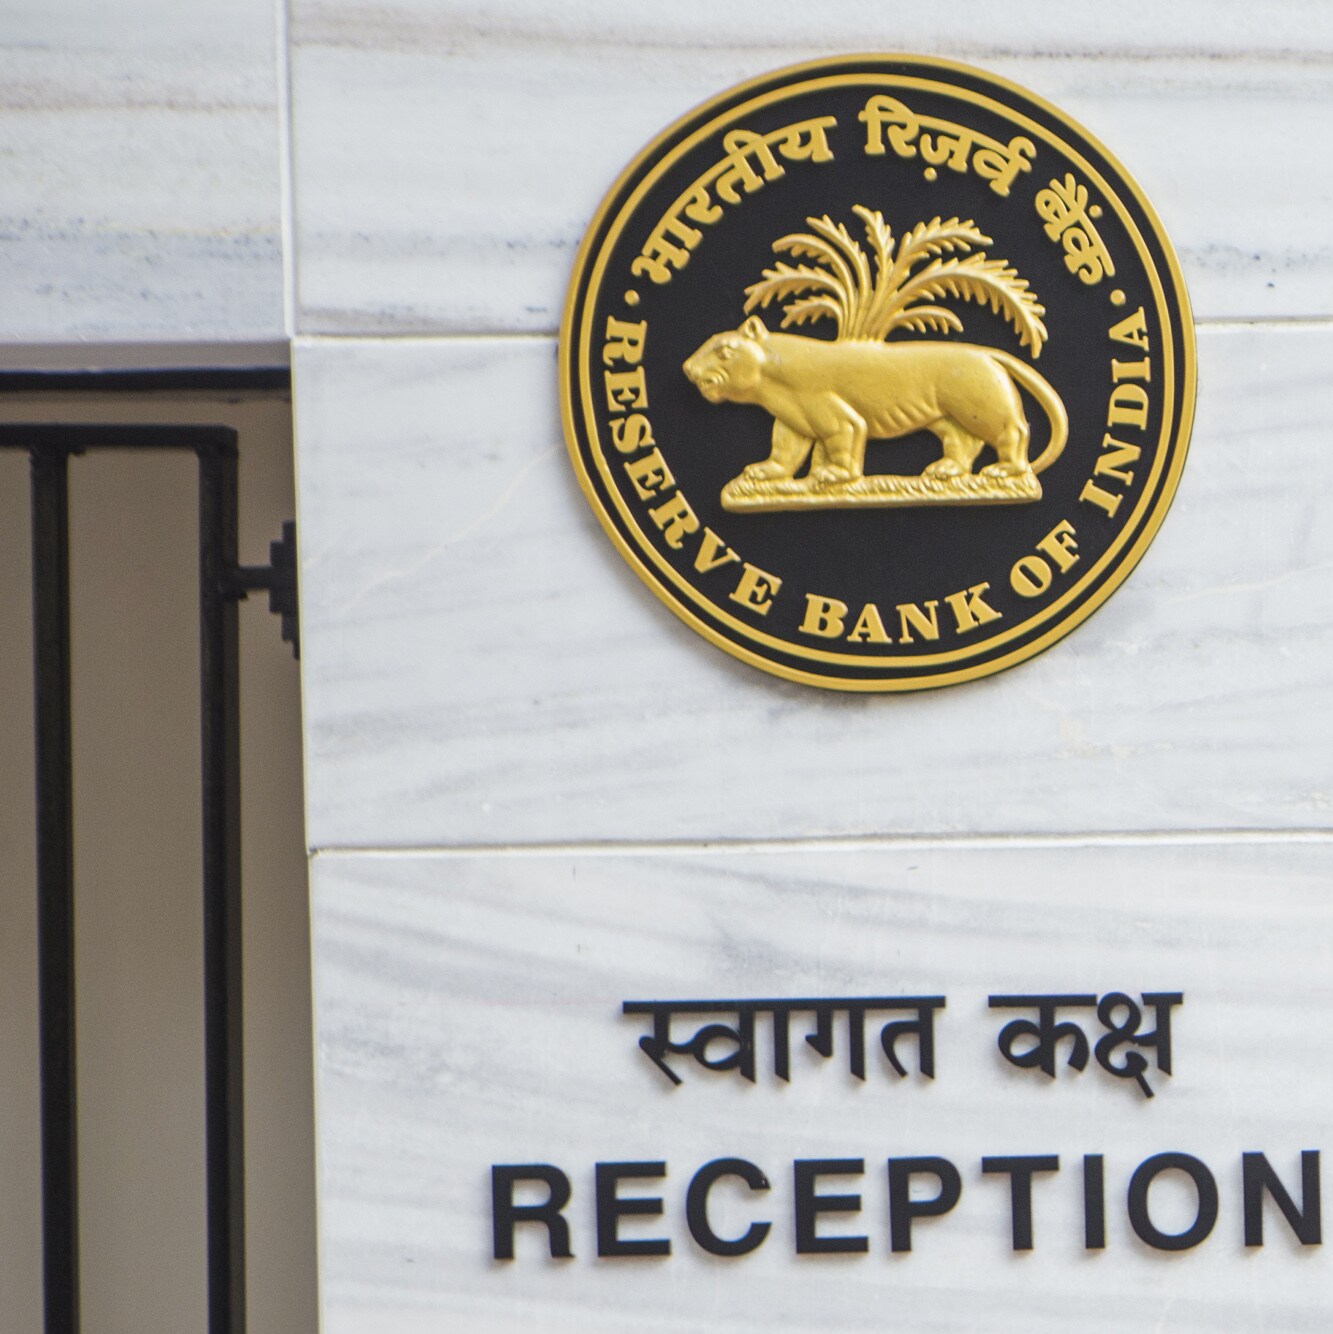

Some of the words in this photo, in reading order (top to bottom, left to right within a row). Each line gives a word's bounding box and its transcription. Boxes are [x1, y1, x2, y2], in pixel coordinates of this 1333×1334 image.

[632, 115, 837, 285] भारतीय
[1035, 173, 1116, 285] बैंक
[602, 315, 783, 616] RESERVE
[798, 581, 1003, 645] BANK
[1009, 519, 1082, 598] OF
[1079, 305, 1152, 519] INDIA
[622, 995, 947, 1086] स्वागत
[988, 991, 1184, 1099] कक्ष
[490, 1149, 1324, 1261] RECEPTION
